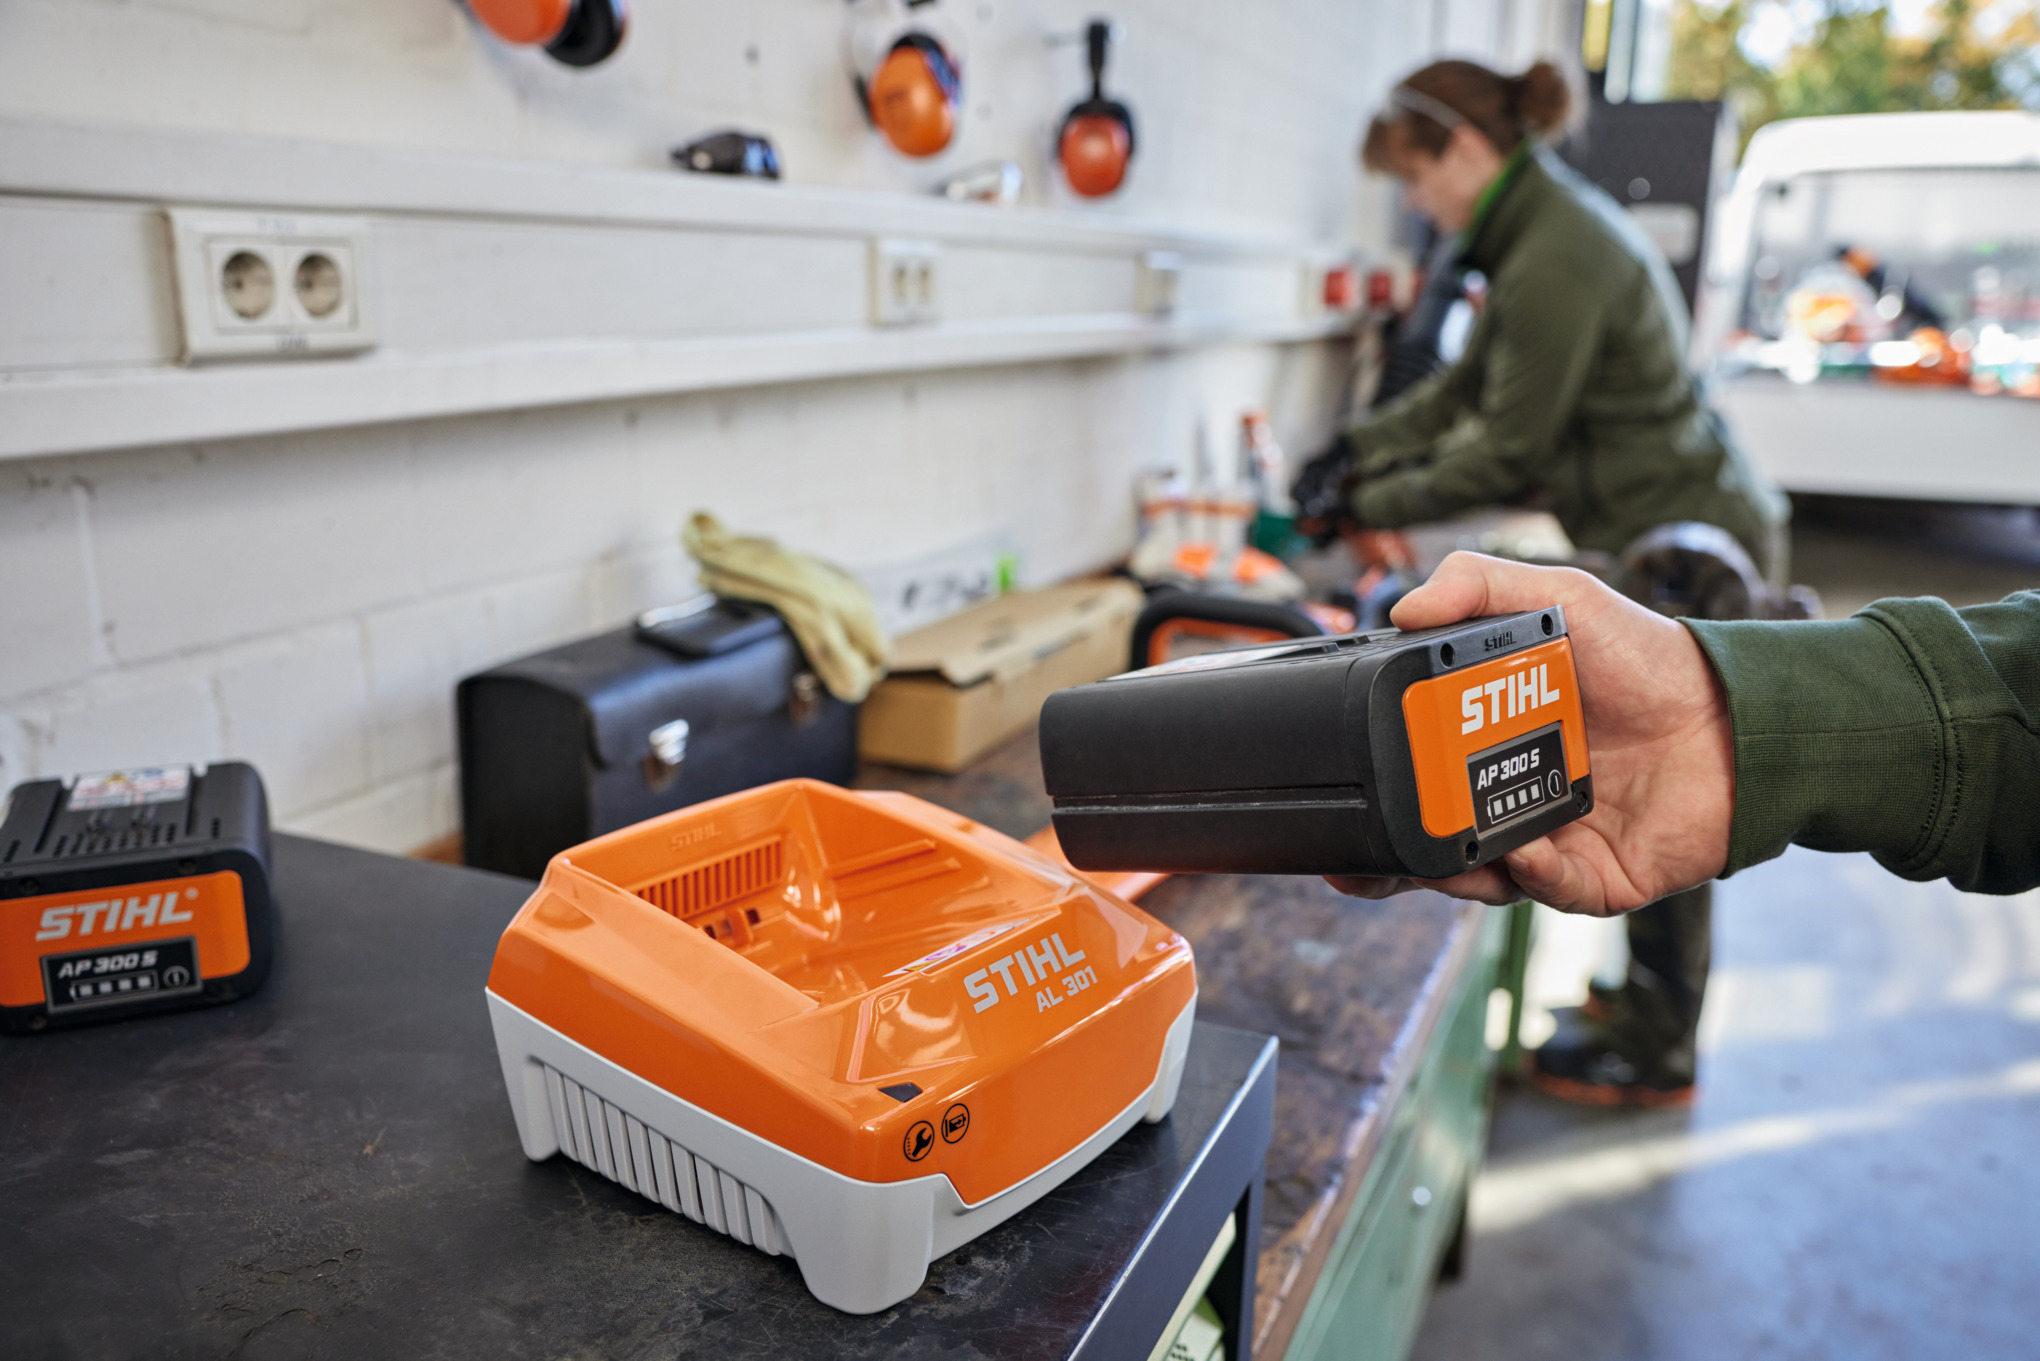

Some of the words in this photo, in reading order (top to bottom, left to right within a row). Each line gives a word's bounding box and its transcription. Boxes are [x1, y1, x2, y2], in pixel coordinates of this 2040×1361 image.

[1485, 631, 1517, 651] STIHL
[1461, 663, 1560, 736] STIHL
[1477, 764, 1498, 790] AP
[1500, 753, 1528, 781] 300
[1530, 748, 1540, 769] S
[671, 822, 723, 850] STIHL
[58, 961, 92, 979] AP
[93, 953, 139, 974] 300
[141, 950, 159, 966] S
[963, 932, 1086, 1014] STIHL
[1035, 987, 1064, 1013] AL
[1061, 965, 1099, 997] 301
